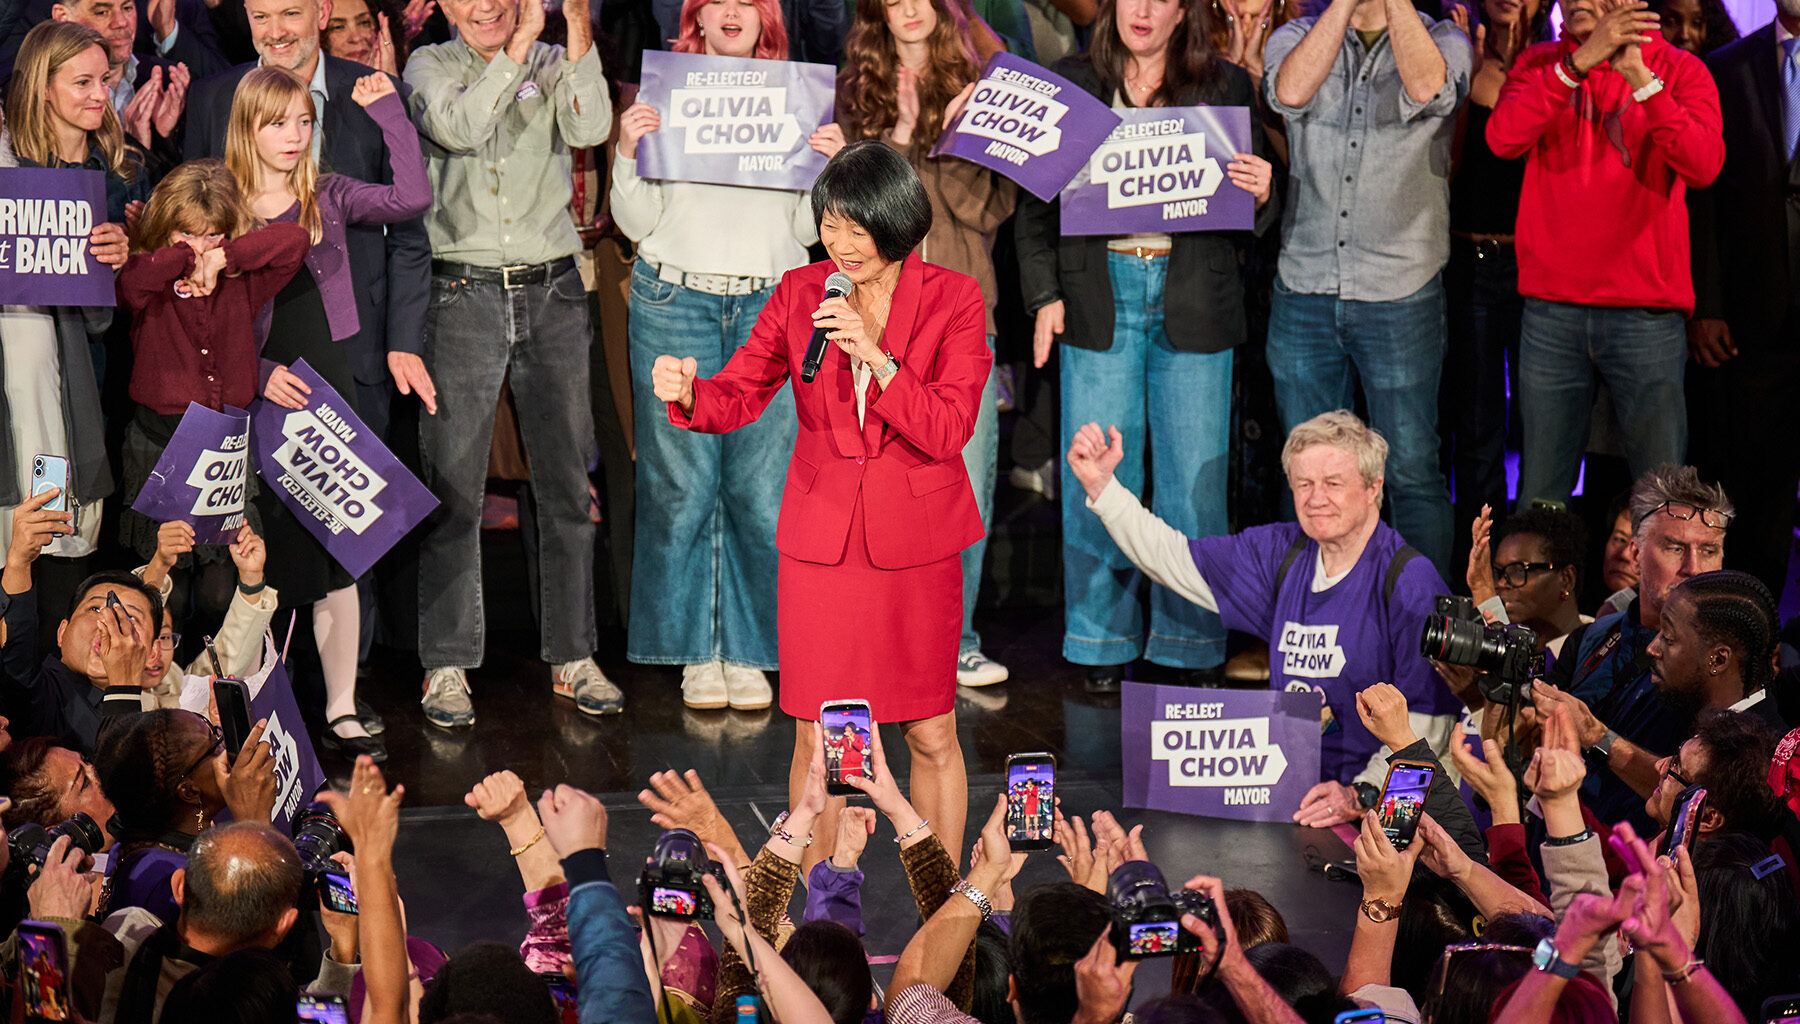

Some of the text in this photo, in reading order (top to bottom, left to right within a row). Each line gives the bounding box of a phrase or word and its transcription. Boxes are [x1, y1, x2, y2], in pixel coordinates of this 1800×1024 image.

[686, 71, 768, 86] RE-ELECTED!
[990, 66, 1062, 97] RE-ELECTED!
[681, 96, 773, 118] OLIVIA
[974, 87, 1049, 122] OLIVIA
[696, 123, 784, 145] CHOW
[970, 110, 1047, 143] CHOW
[738, 154, 785, 171] MAYOR
[984, 140, 1030, 166] MAYOR
[1102, 144, 1193, 173] OLIVIA
[1120, 168, 1206, 197] CHOW
[1163, 199, 1208, 220] MAYOR
[16, 237, 88, 274] BACK
[315, 402, 358, 444] MAYOR
[295, 425, 370, 491] CHOW
[206, 483, 243, 507] CHO
[289, 446, 365, 519] OLIVIA
[276, 473, 346, 536] RE-ELECTED!
[1286, 652, 1333, 670] CHOW
[1165, 703, 1224, 719] RE-ELECT
[1163, 728, 1255, 751] OLIVIA
[1180, 755, 1268, 777] CHOW
[284, 778, 304, 822] MAYOR
[1224, 788, 1271, 805] MAYOR
